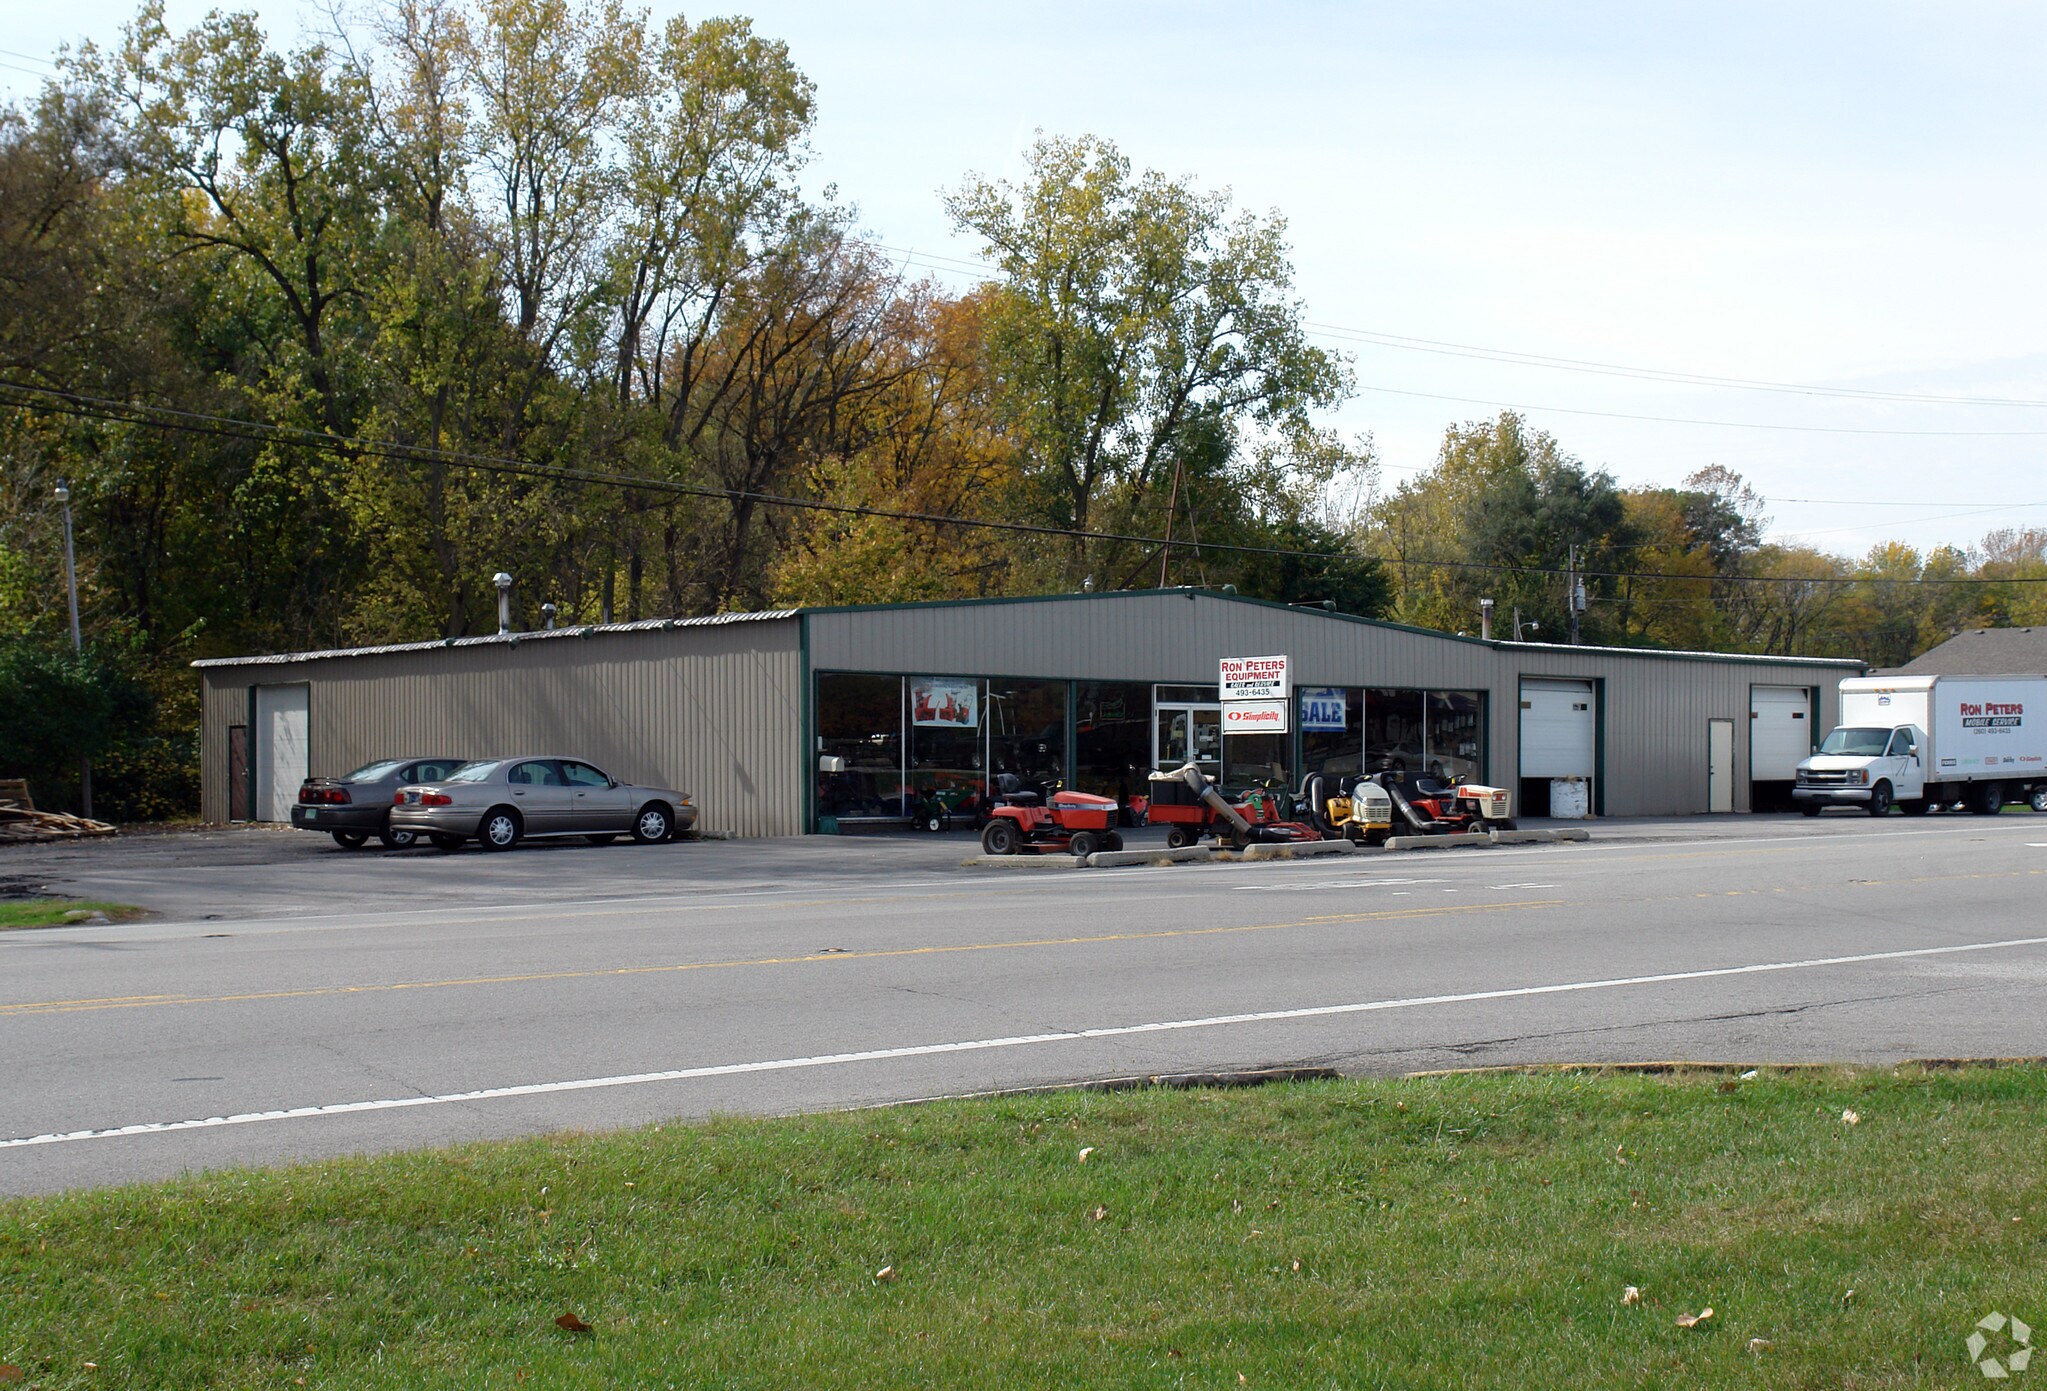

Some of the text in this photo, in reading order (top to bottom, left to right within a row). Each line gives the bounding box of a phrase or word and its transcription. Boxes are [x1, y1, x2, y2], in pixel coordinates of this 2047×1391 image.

[1221, 660, 1285, 672] RON PETERS
[1225, 671, 1280, 681] EQUIPMENT
[1235, 688, 1270, 697] 493-6435
[1960, 702, 2023, 716] RON PETERS
[1242, 711, 1280, 722] Simplicity
[1965, 717, 2019, 727] MOBILE SERVICE
